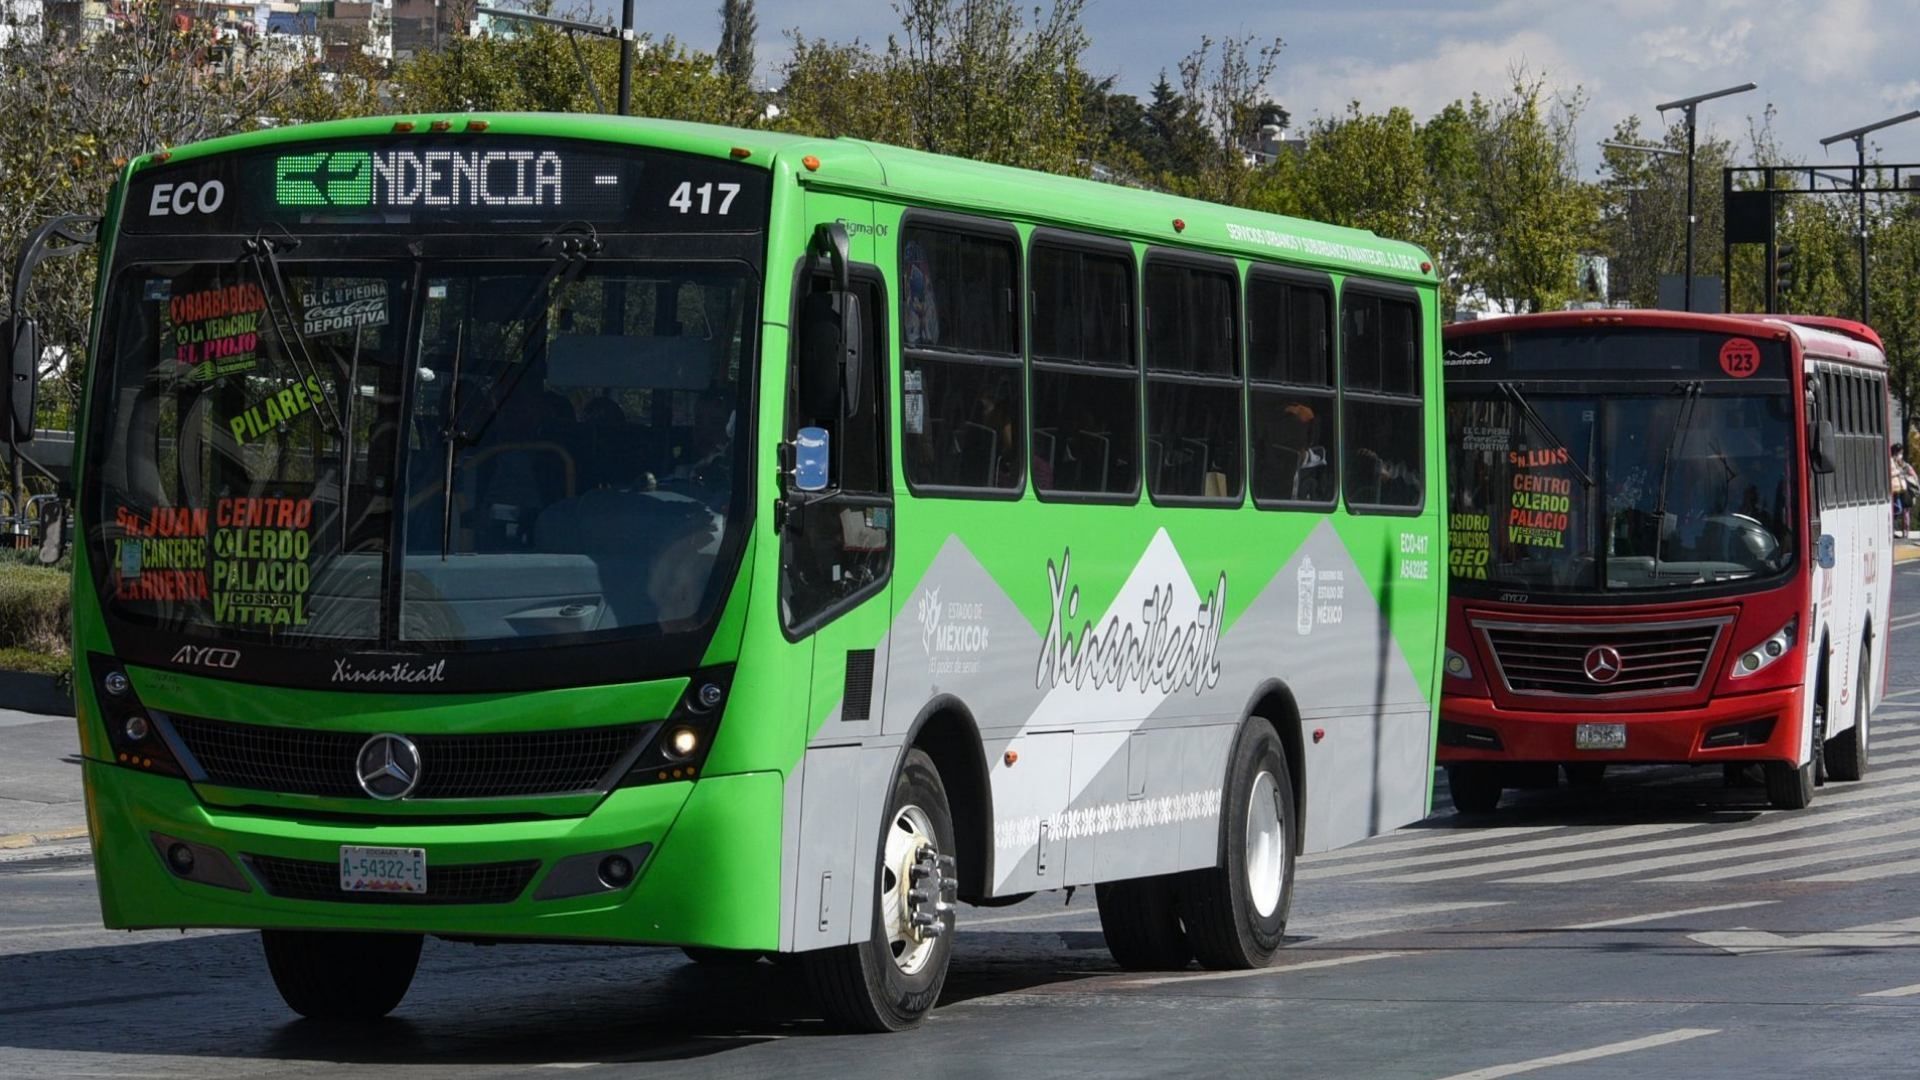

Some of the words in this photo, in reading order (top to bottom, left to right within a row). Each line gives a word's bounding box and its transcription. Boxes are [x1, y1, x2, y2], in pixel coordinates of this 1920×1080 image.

[372, 151, 562, 205] NDENCIA
[148, 180, 225, 216] ECO
[669, 182, 741, 216] 417
[185, 283, 267, 322] BARBABOSA
[345, 283, 386, 301] PIEDRA
[205, 313, 257, 340] VERACRUZ
[304, 310, 386, 334] DEPORTIVA
[203, 333, 257, 360] PIOJO
[1726, 353, 1753, 372] 123
[230, 374, 324, 446] PILARES
[1528, 447, 1568, 467] LUIS
[1513, 474, 1571, 495] CENTRO
[216, 497, 311, 529] CENTRO
[1524, 493, 1570, 513] LERDO
[144, 506, 208, 537] JUAN
[1450, 513, 1490, 532] ISIDRO
[1509, 508, 1568, 531] PALACIO
[235, 529, 310, 561] LERDO
[1400, 532, 1428, 554] ECO-417
[1509, 526, 1565, 549] VITRAL
[114, 537, 207, 569] ZCANTEPEC
[1449, 548, 1490, 566] GEO
[141, 570, 209, 599] HUERTA
[213, 560, 310, 593] PALACIO
[213, 592, 310, 625] VITRAL
[948, 602, 973, 620] ESTADO
[974, 603, 984, 620] DE
[936, 622, 981, 653] MÉXICO
[331, 657, 446, 683] Xinantécatl
[343, 857, 422, 881] A-54322-E
